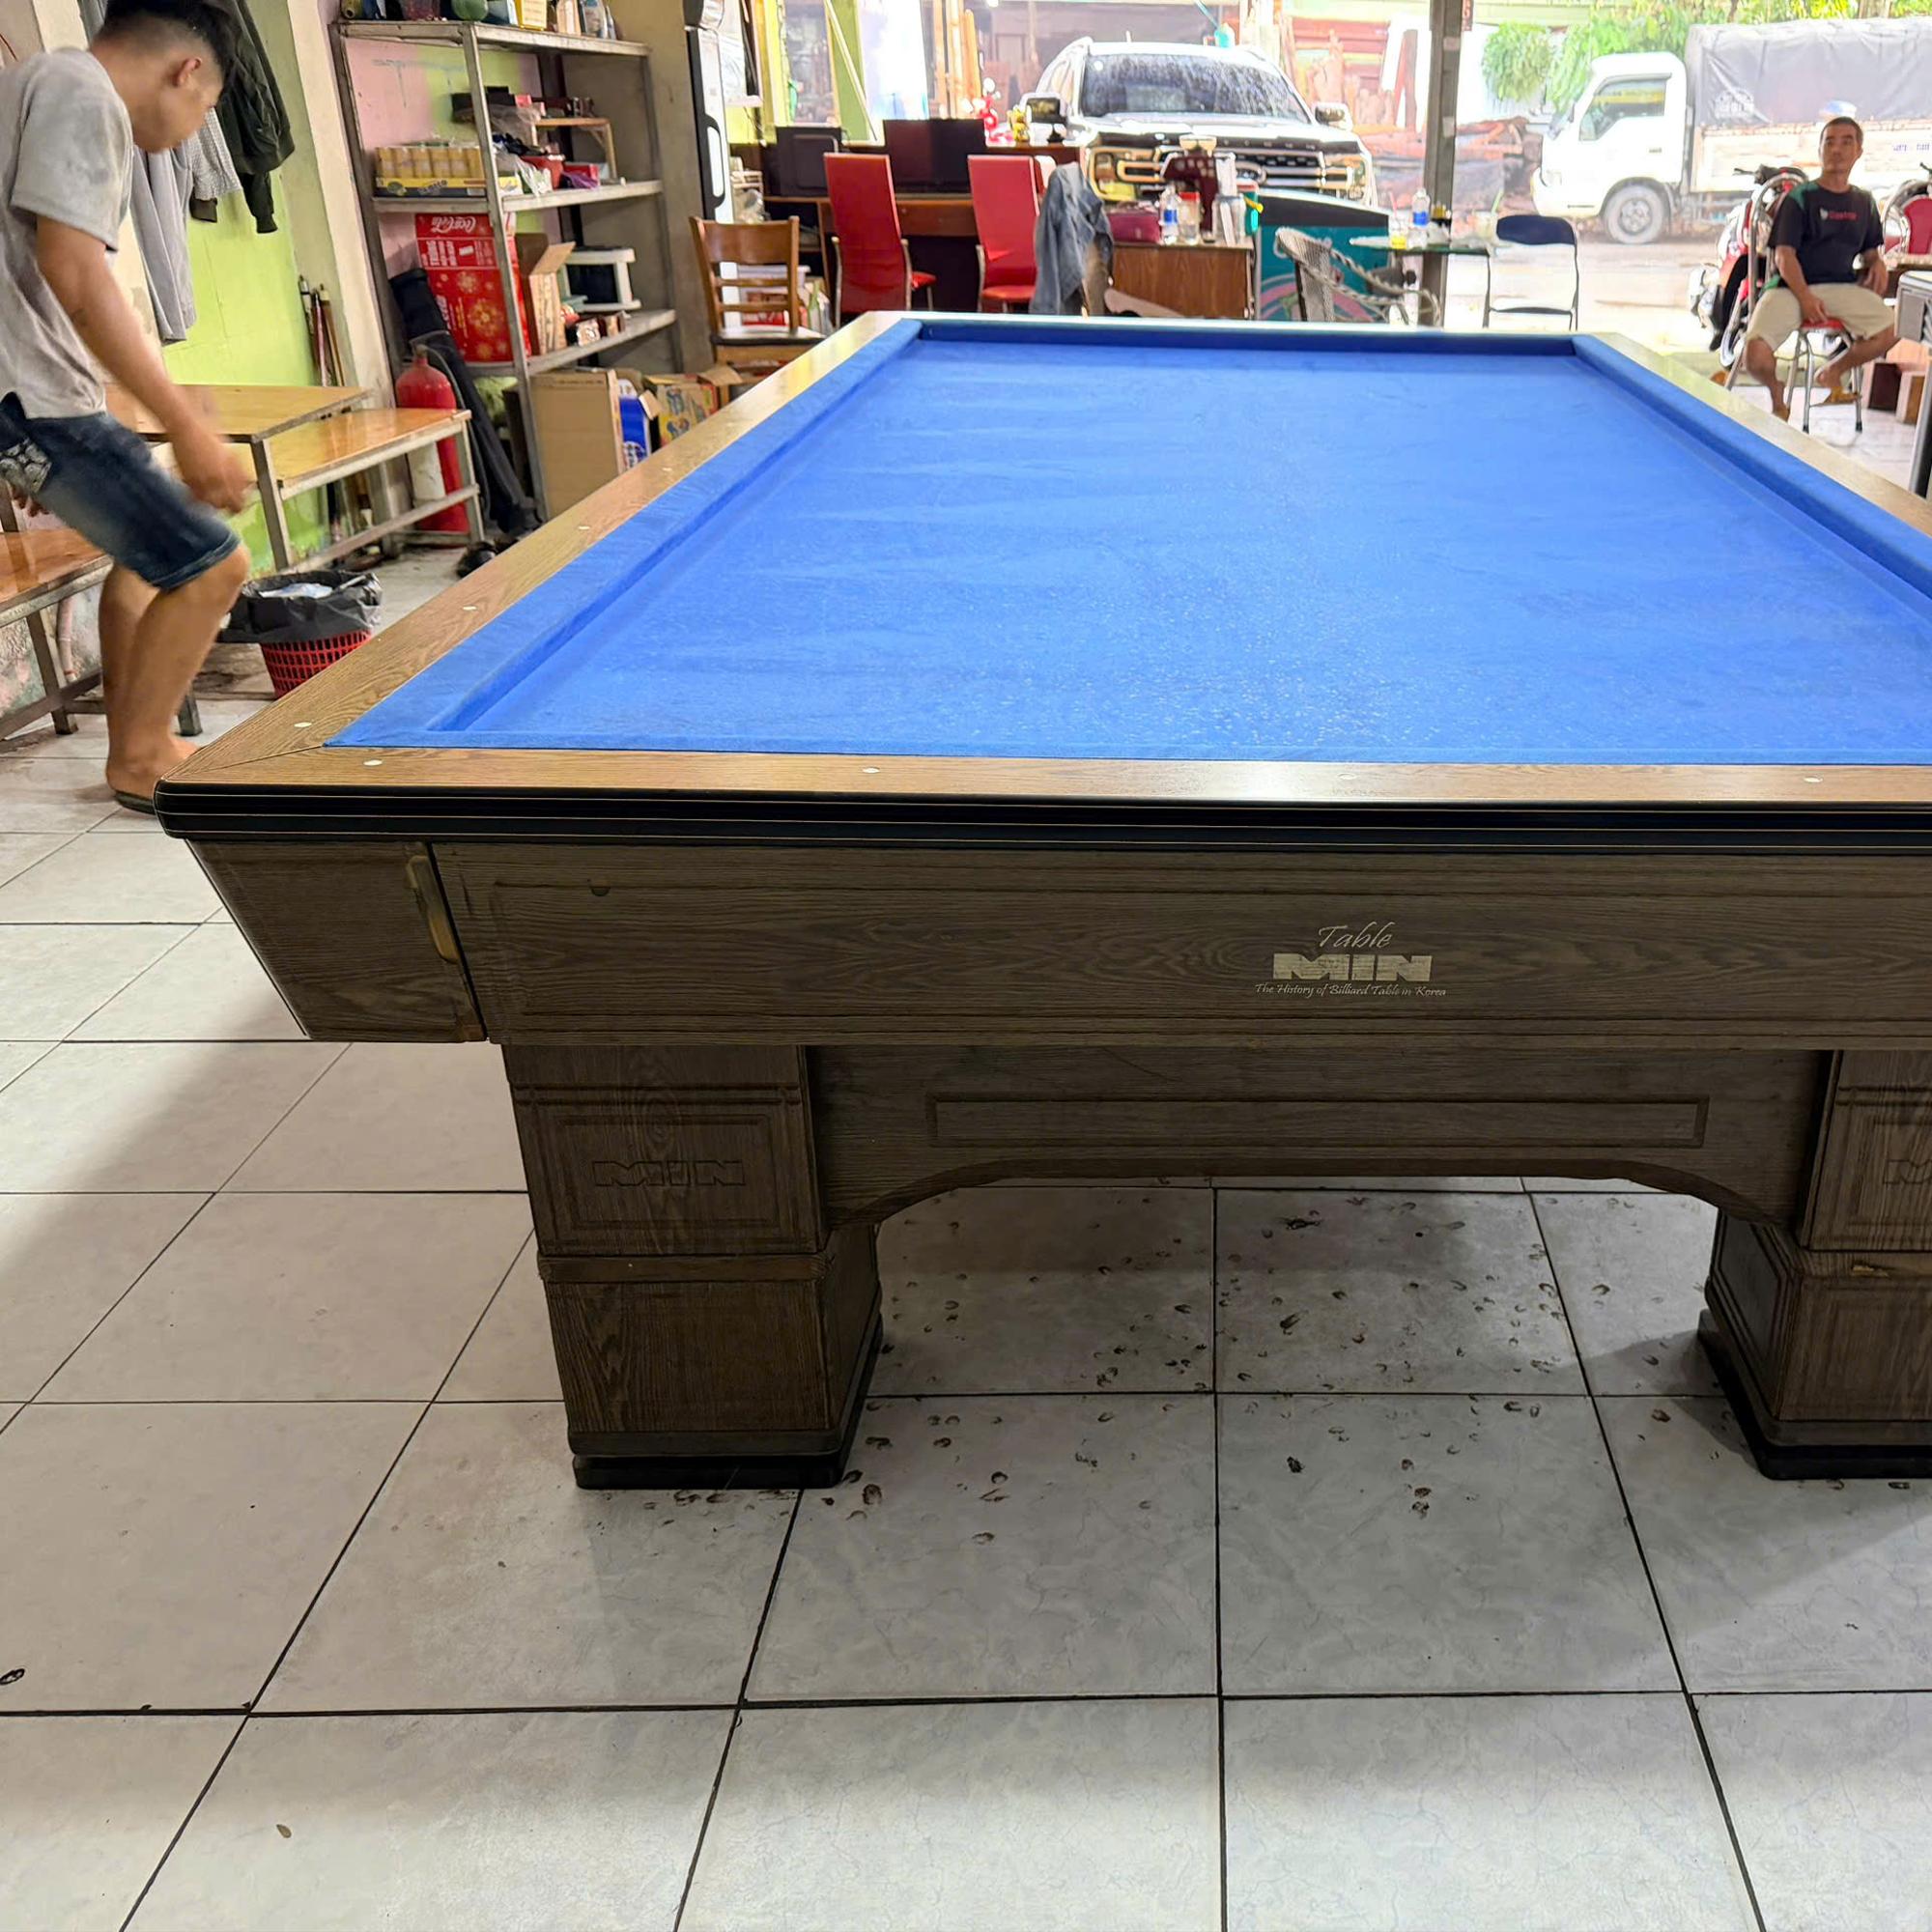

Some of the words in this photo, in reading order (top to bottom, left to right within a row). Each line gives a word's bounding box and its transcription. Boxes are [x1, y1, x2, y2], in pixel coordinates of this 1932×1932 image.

[1318, 921, 1396, 949] Table
[1273, 952, 1433, 982] MIN
[1255, 982, 1274, 993] The
[1277, 983, 1315, 999] History
[1316, 983, 1329, 997] of
[1328, 982, 1371, 995] Billiard
[1371, 983, 1399, 996] Table
[1401, 987, 1411, 996] in
[1414, 985, 1446, 997] Korea
[591, 1160, 746, 1187] MIN
